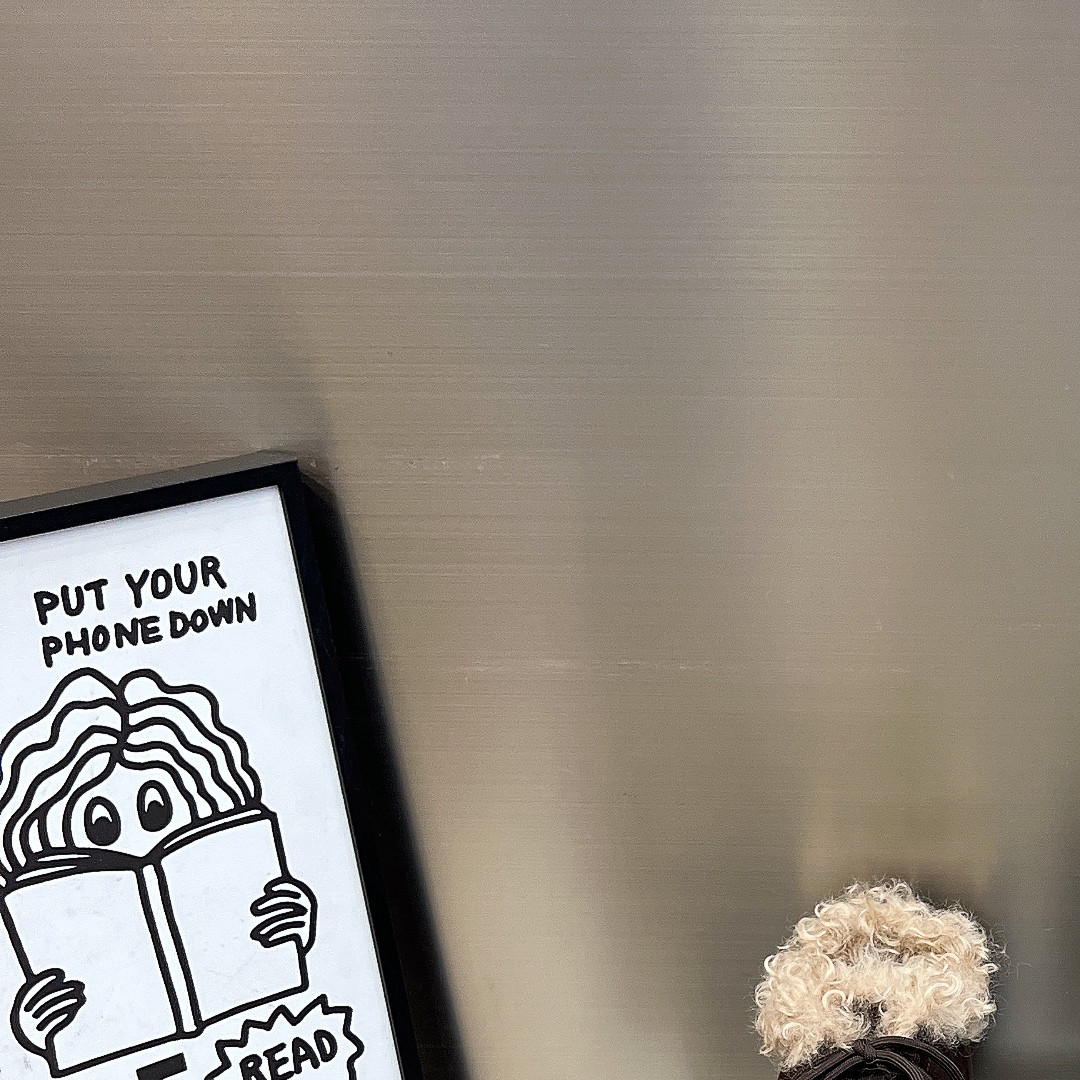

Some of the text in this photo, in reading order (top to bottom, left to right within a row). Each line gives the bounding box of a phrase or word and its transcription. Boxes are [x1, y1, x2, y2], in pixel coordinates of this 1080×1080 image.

[33, 555, 228, 626] PUT YOUR
[41, 591, 257, 669] PHONE DOWN
